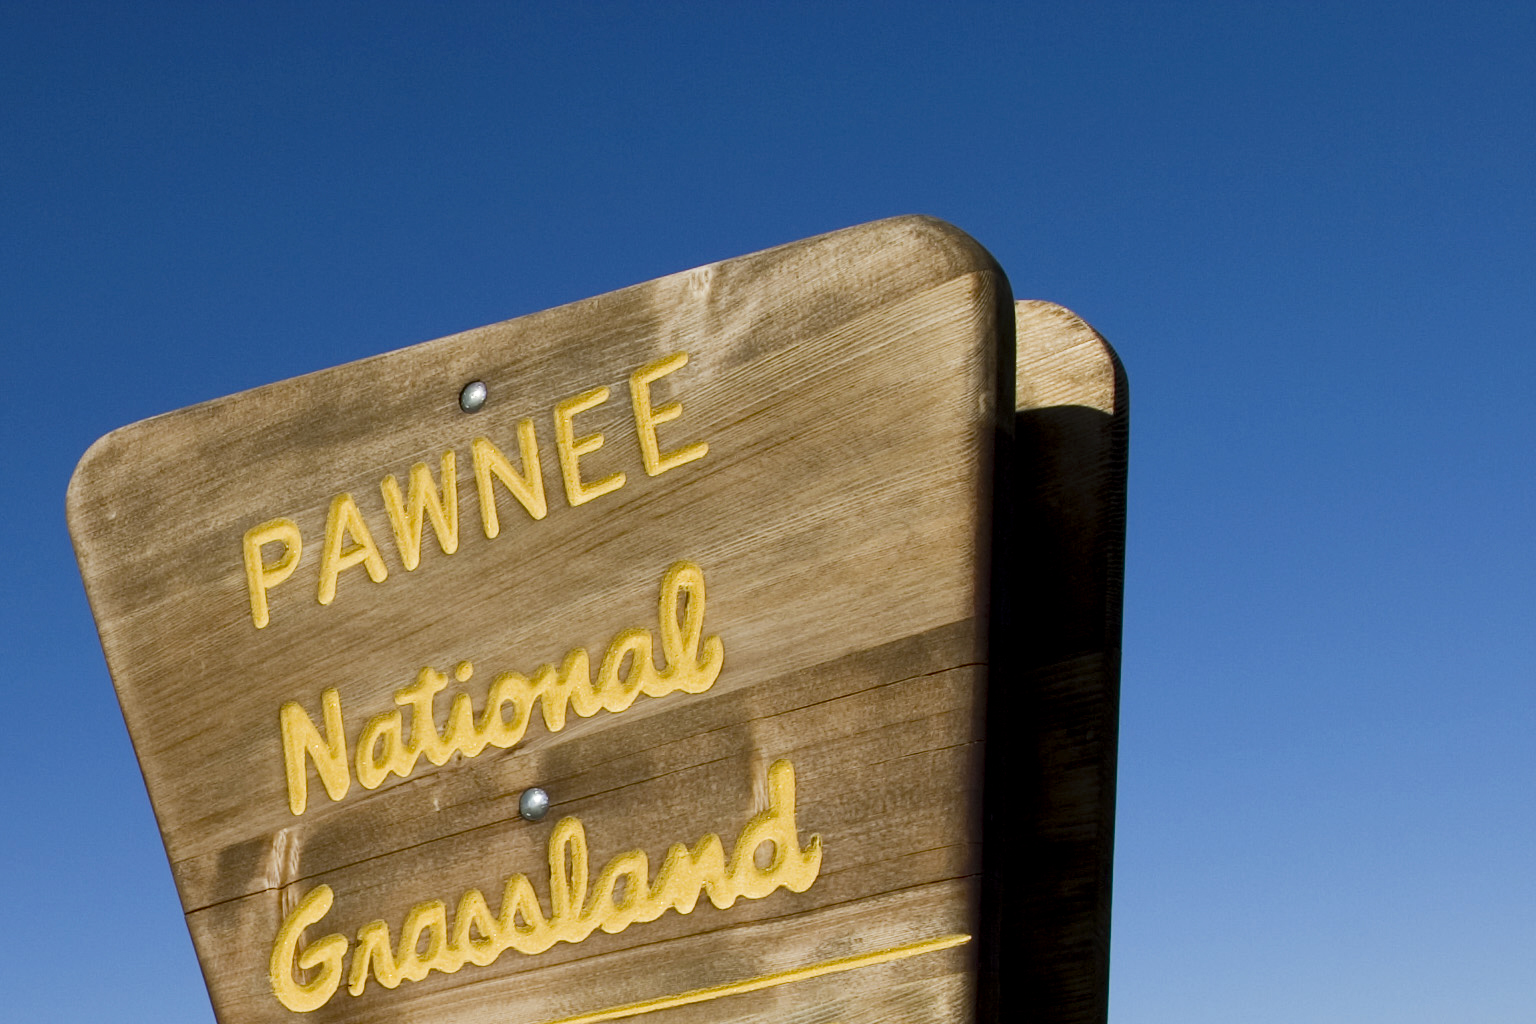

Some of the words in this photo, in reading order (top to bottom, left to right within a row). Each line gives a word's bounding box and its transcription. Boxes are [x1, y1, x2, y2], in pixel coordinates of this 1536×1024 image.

[242, 350, 709, 629] PAWNEE
[280, 559, 724, 816] National
[270, 759, 823, 1013] Grassland
